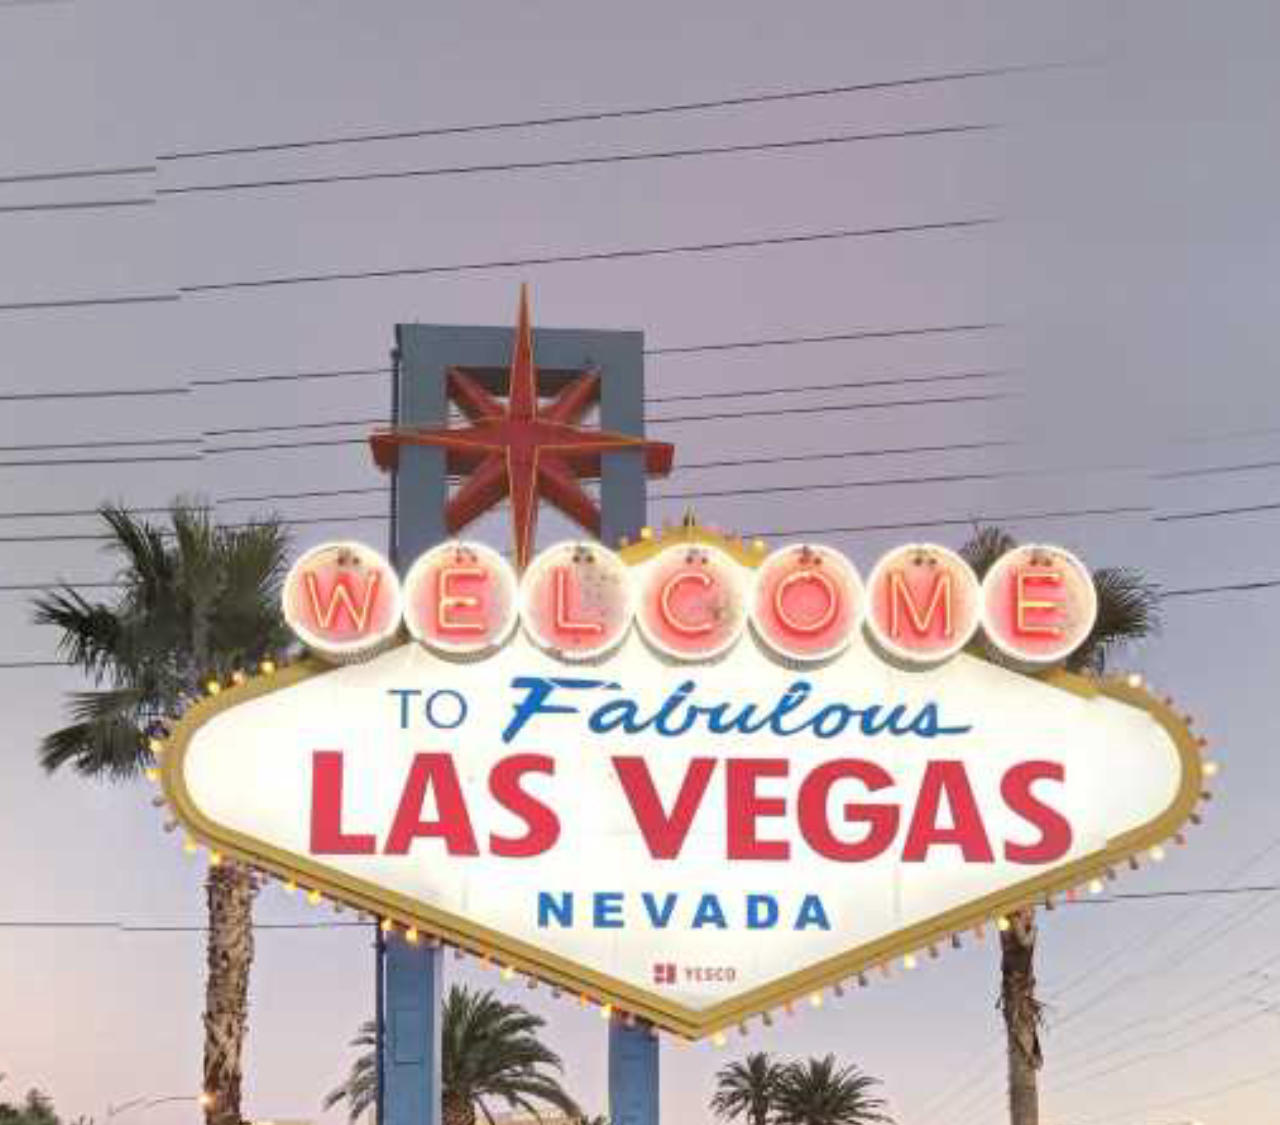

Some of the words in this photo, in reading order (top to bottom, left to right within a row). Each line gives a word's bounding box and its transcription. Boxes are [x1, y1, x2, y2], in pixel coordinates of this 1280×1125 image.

[302, 562, 1068, 642] WELCOME
[387, 688, 469, 730] TO
[500, 676, 972, 744] Fabulous
[308, 750, 561, 858] LAS
[612, 756, 1074, 865] VEGAS
[537, 890, 832, 932] NEVADA
[685, 966, 737, 982] YESCO
